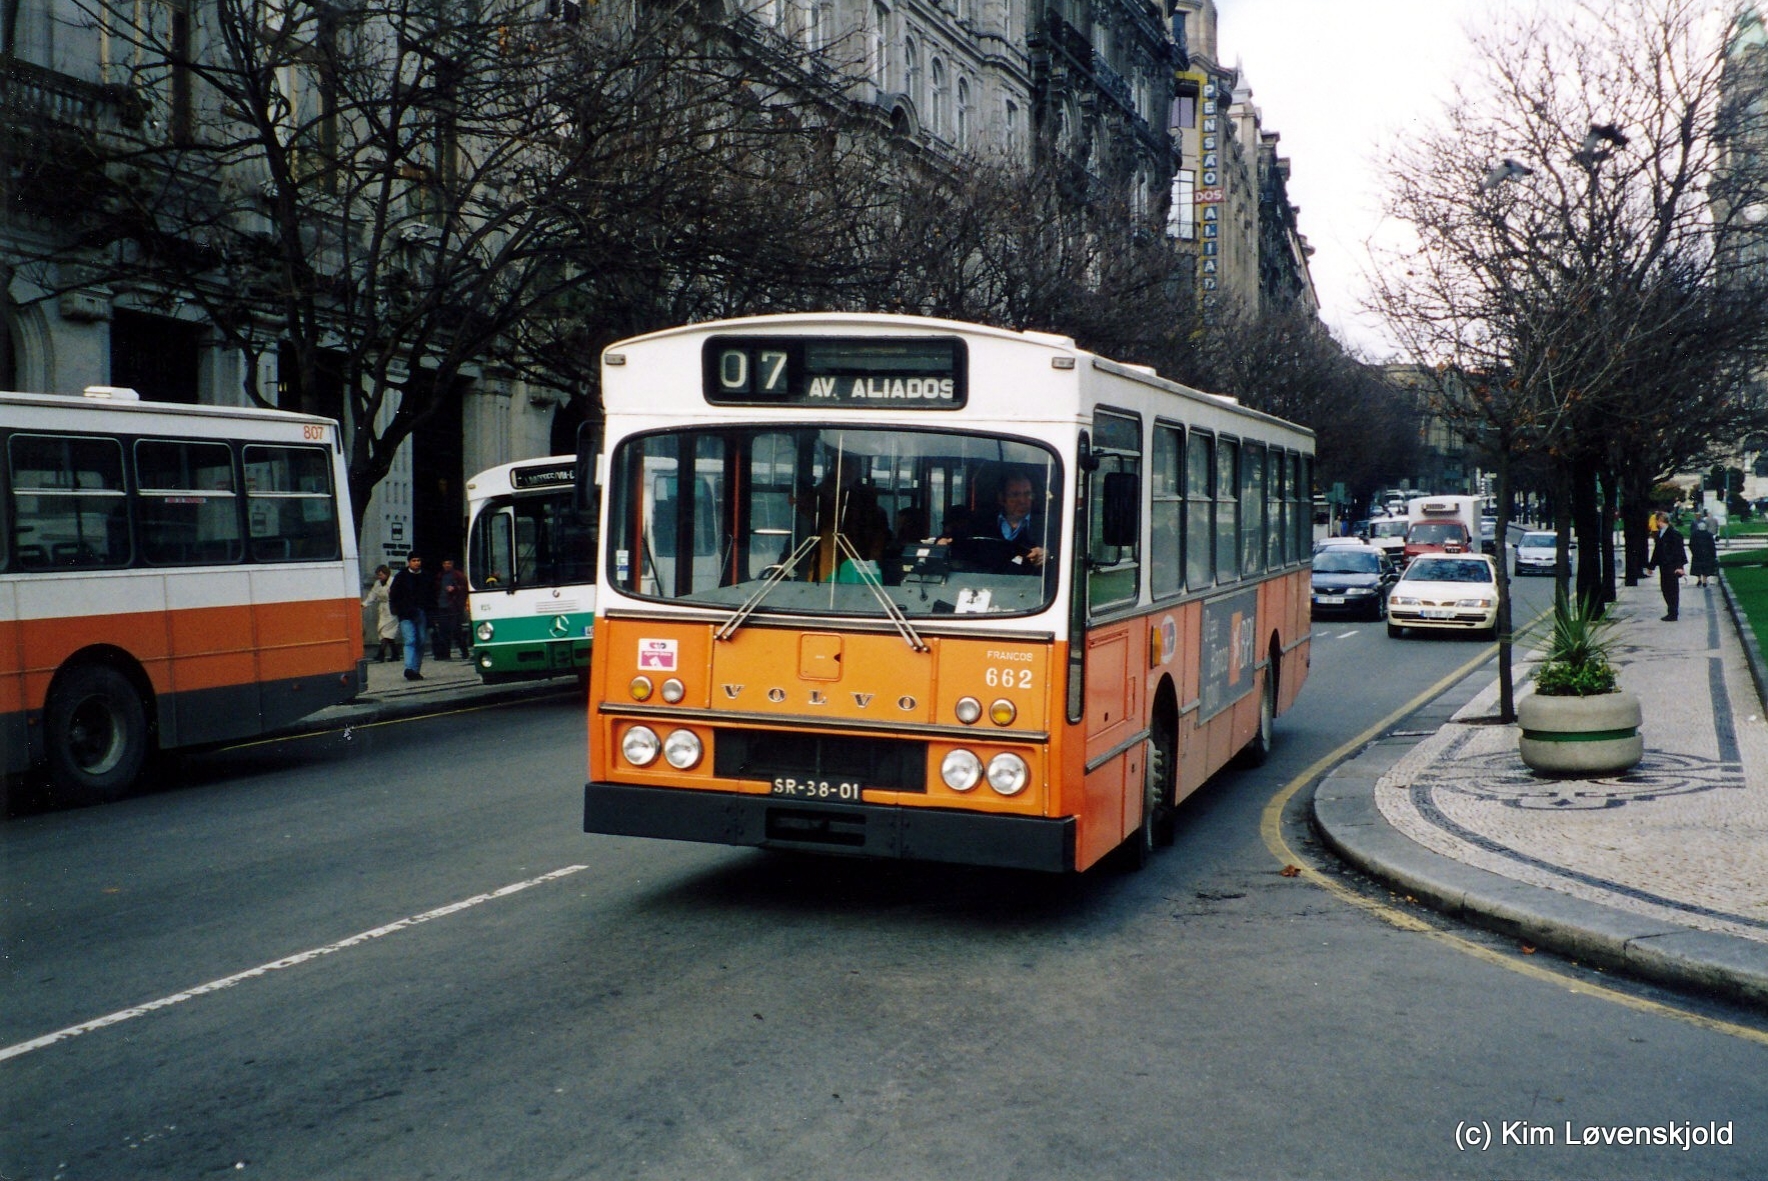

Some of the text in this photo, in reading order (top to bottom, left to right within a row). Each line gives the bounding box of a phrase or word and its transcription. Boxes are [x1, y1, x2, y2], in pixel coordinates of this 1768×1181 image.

[1195, 189, 1222, 201] DOS
[720, 350, 788, 390] 07
[809, 377, 954, 399] AV. ALIADOS
[303, 425, 324, 440] 807
[986, 650, 1033, 662] FRANCOS
[985, 667, 1033, 689] 662
[721, 683, 917, 712] VOLVO
[774, 778, 859, 800] SR-38-01
